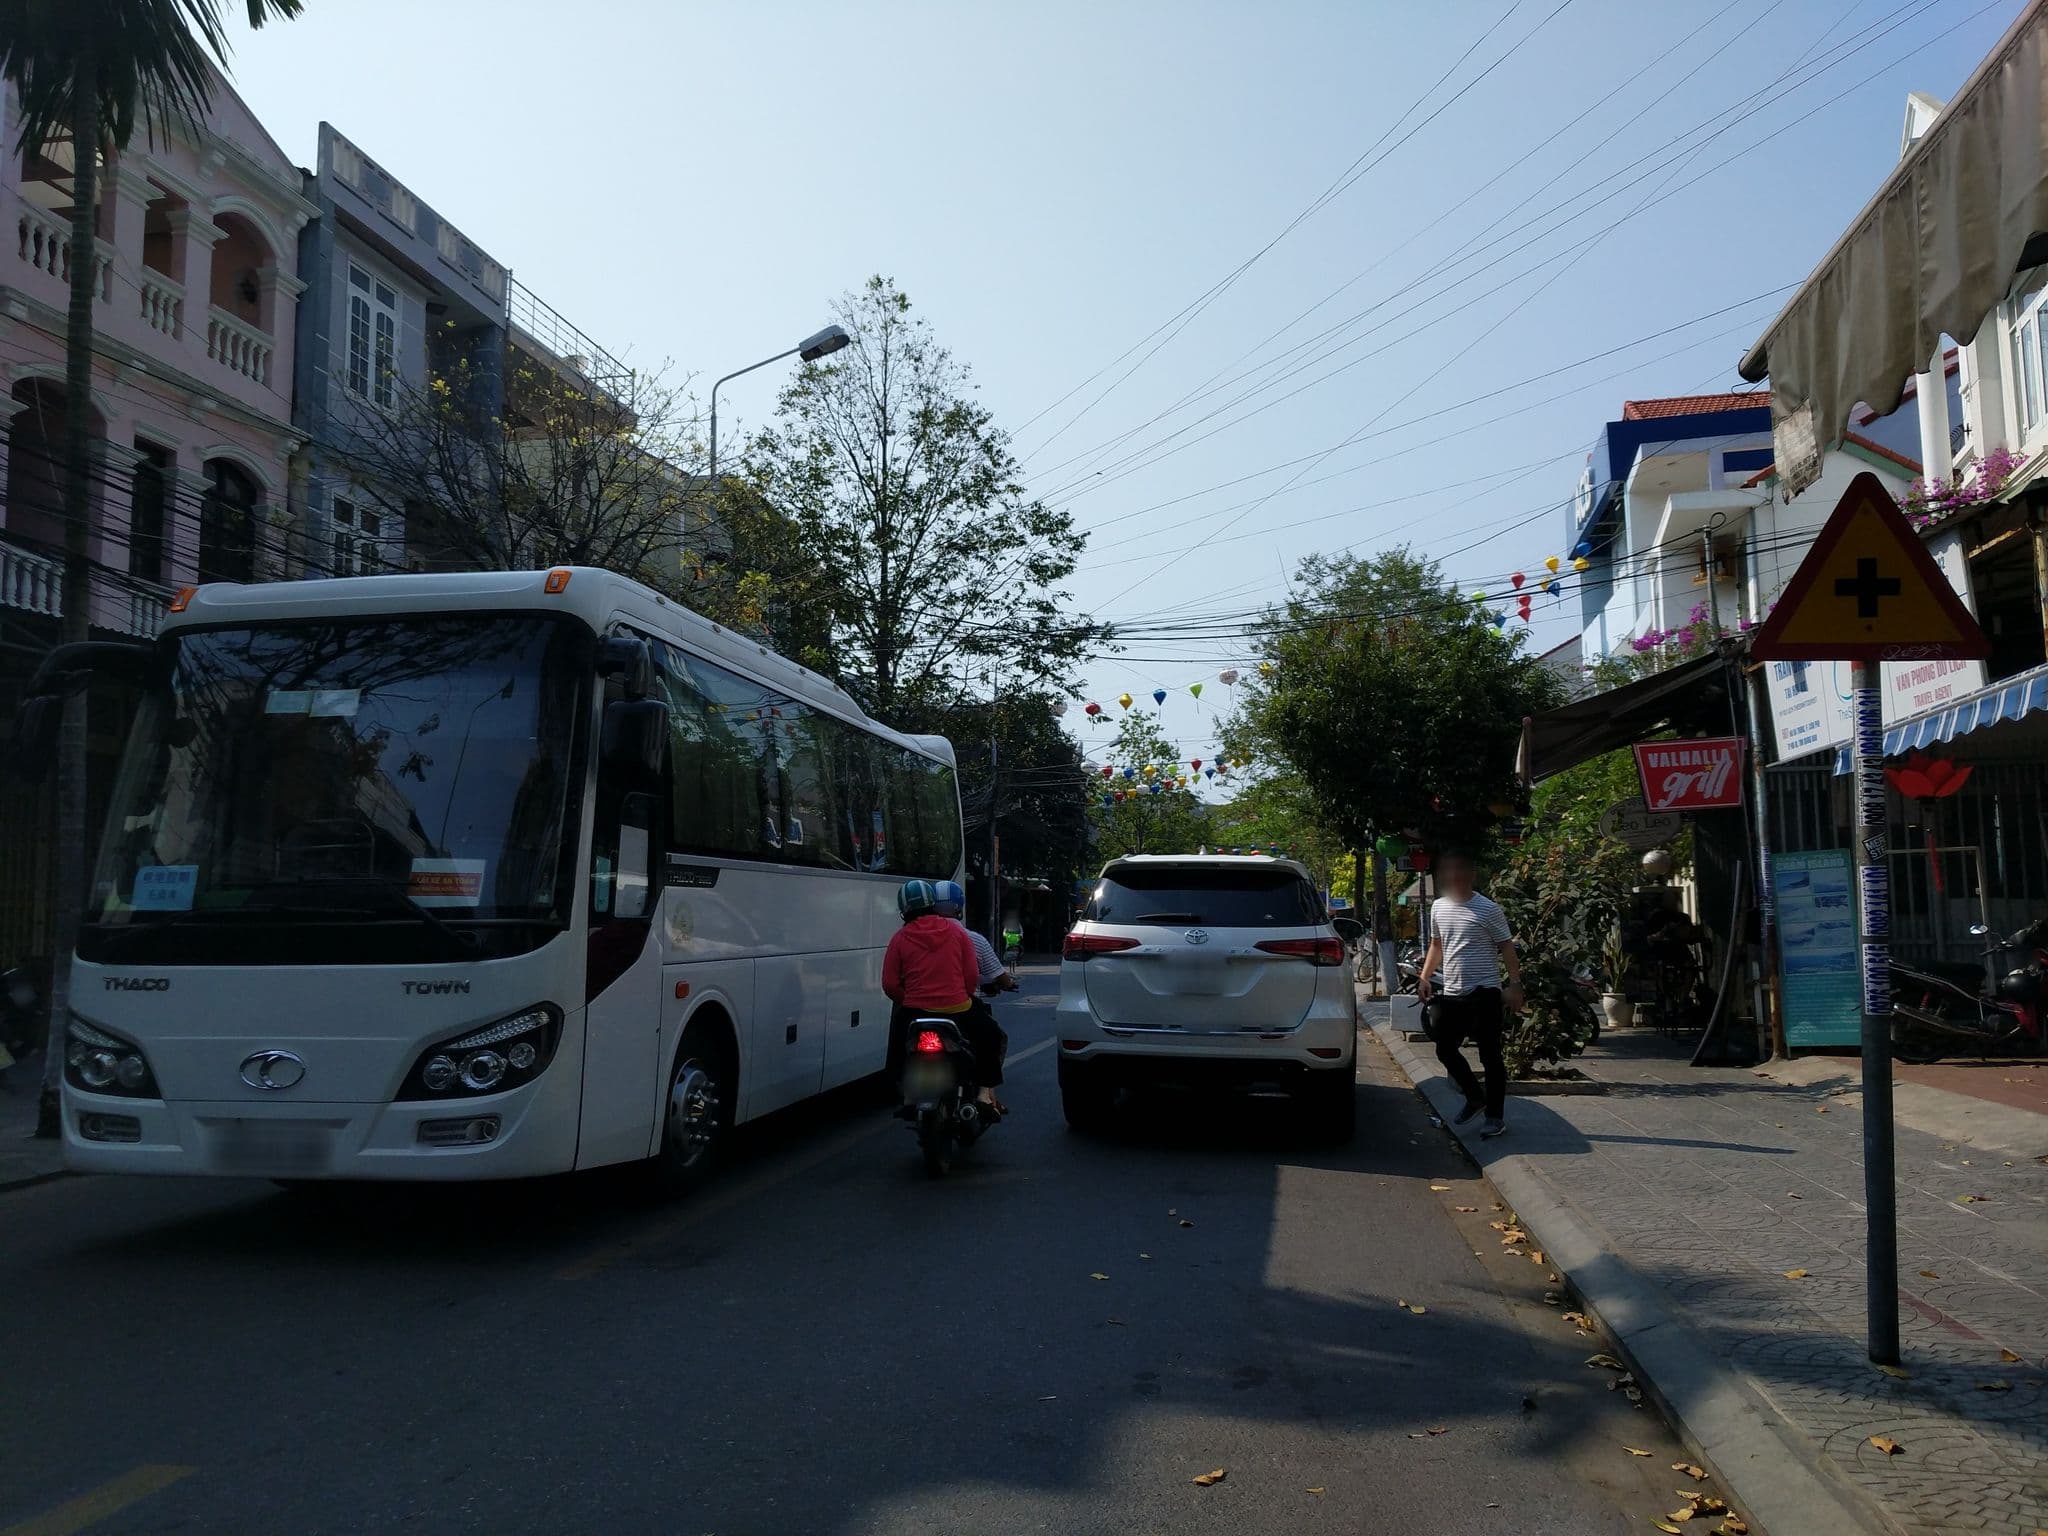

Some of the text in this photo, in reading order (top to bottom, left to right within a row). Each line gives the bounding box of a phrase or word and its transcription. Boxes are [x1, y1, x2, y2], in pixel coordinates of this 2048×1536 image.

[1914, 683, 1953, 708] TRAVEL AGENT
[1648, 748, 1730, 768] VALHALLA
[1657, 759, 1733, 808] grill
[104, 976, 170, 992] THACO
[401, 979, 470, 995] TOWN
